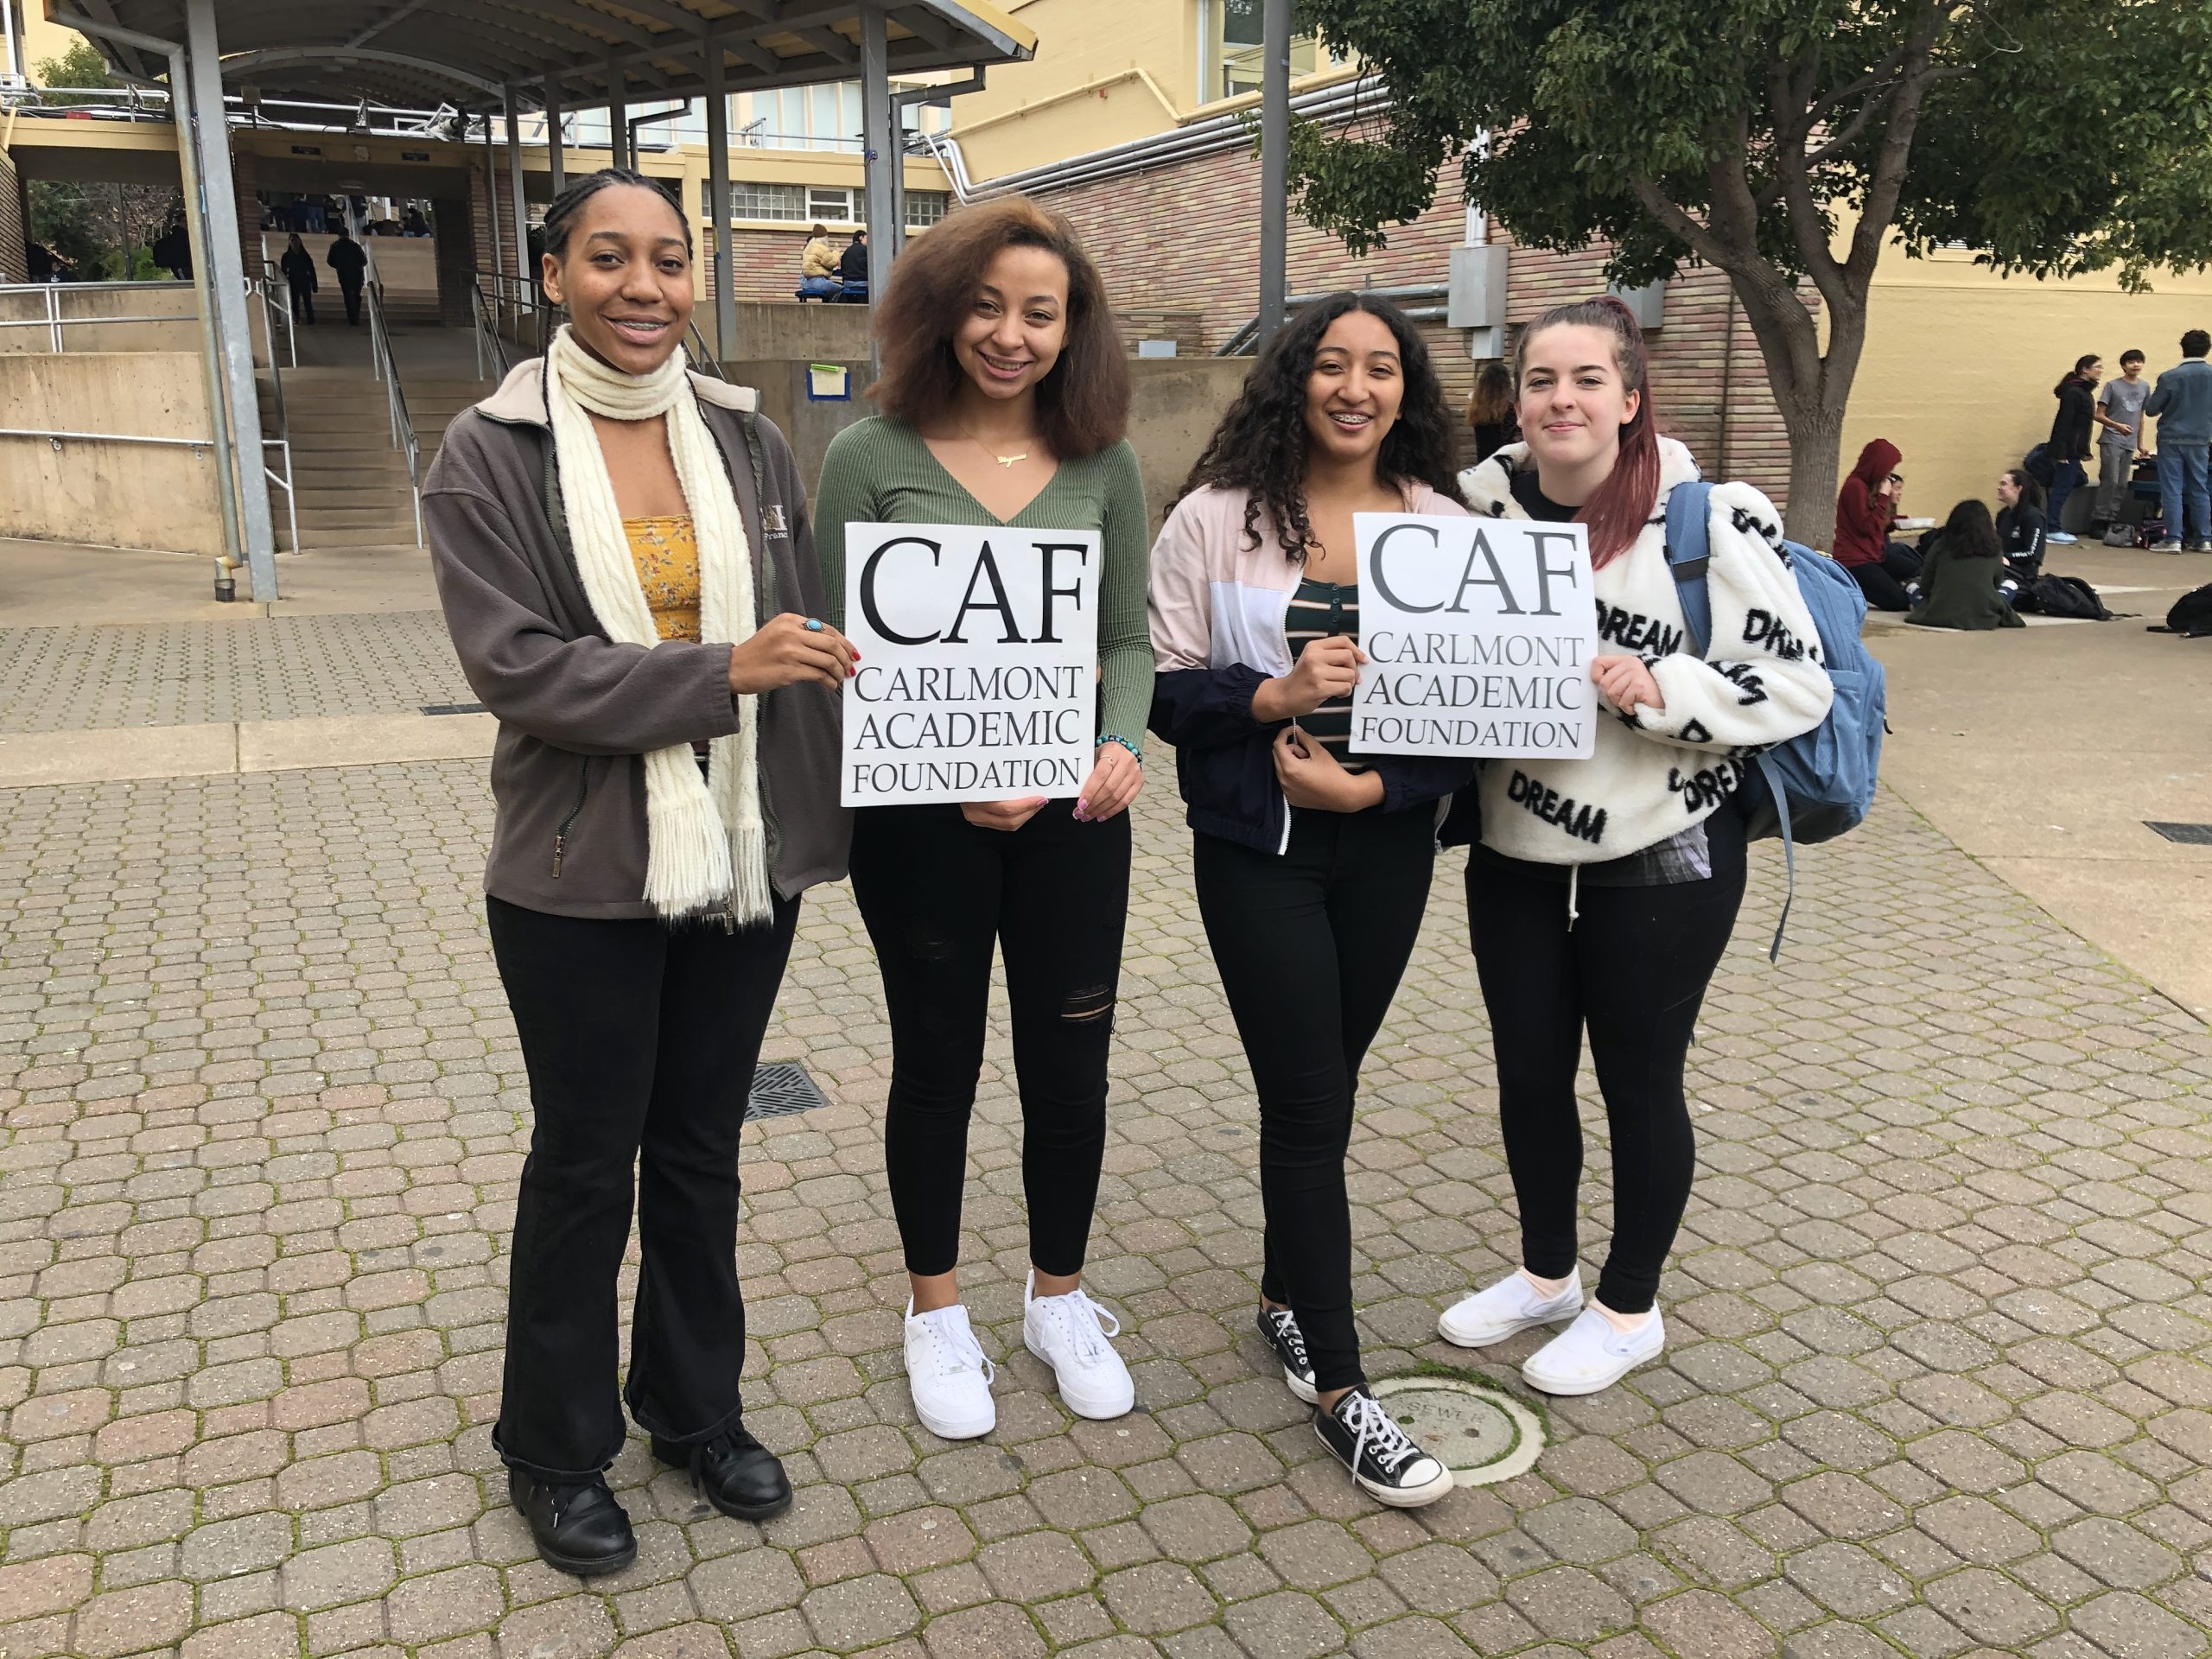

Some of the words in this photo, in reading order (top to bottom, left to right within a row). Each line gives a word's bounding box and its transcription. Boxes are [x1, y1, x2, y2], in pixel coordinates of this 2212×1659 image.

[1370, 524, 1578, 616] CAF
[860, 537, 1089, 645] CAF
[1368, 631, 1585, 667] CARLMONT
[854, 665, 1084, 702] CARLMONT
[1363, 672, 1581, 709] ACADEMIC
[854, 709, 1080, 749] ACADEMIC
[1358, 716, 1582, 748] FOUNDATION
[852, 758, 1081, 793] FOUNDATION
[1508, 769, 1607, 844] DREAM
